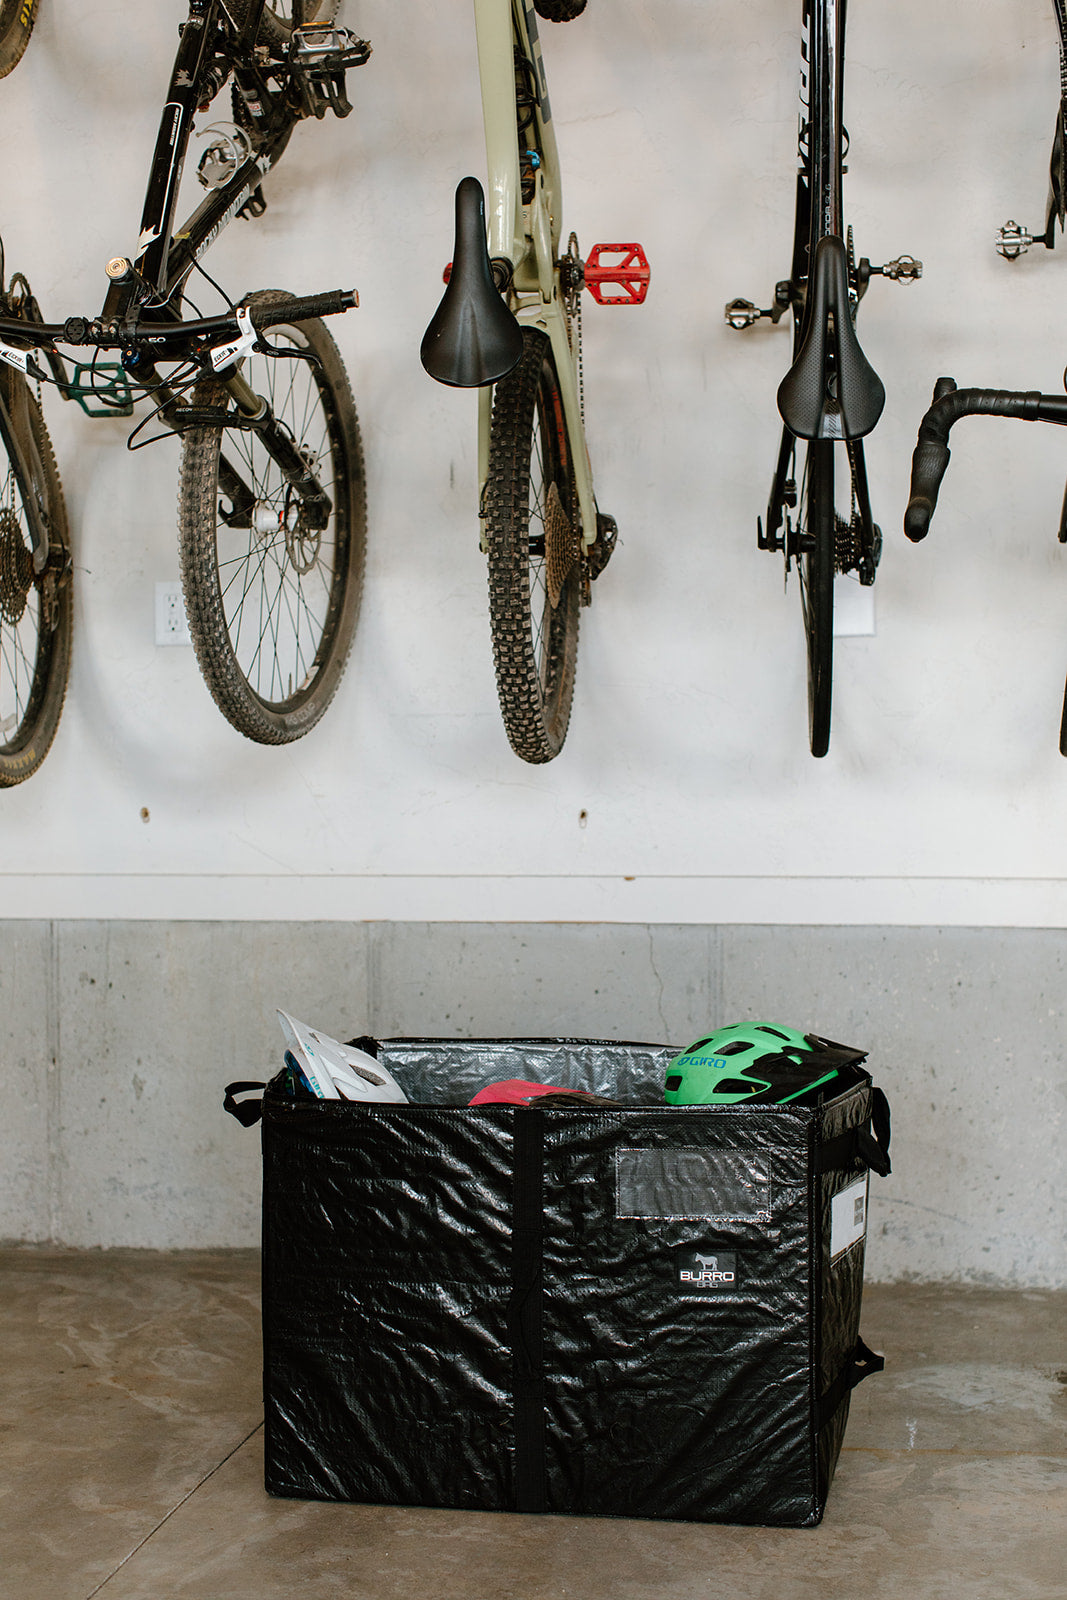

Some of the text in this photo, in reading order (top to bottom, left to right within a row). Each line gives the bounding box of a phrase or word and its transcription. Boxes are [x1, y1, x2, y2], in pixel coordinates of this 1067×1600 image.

[195, 182, 252, 262] ROCKY MOUNTAIN
[689, 1056, 727, 1069] GIRO
[680, 1271, 735, 1282] BURRO
